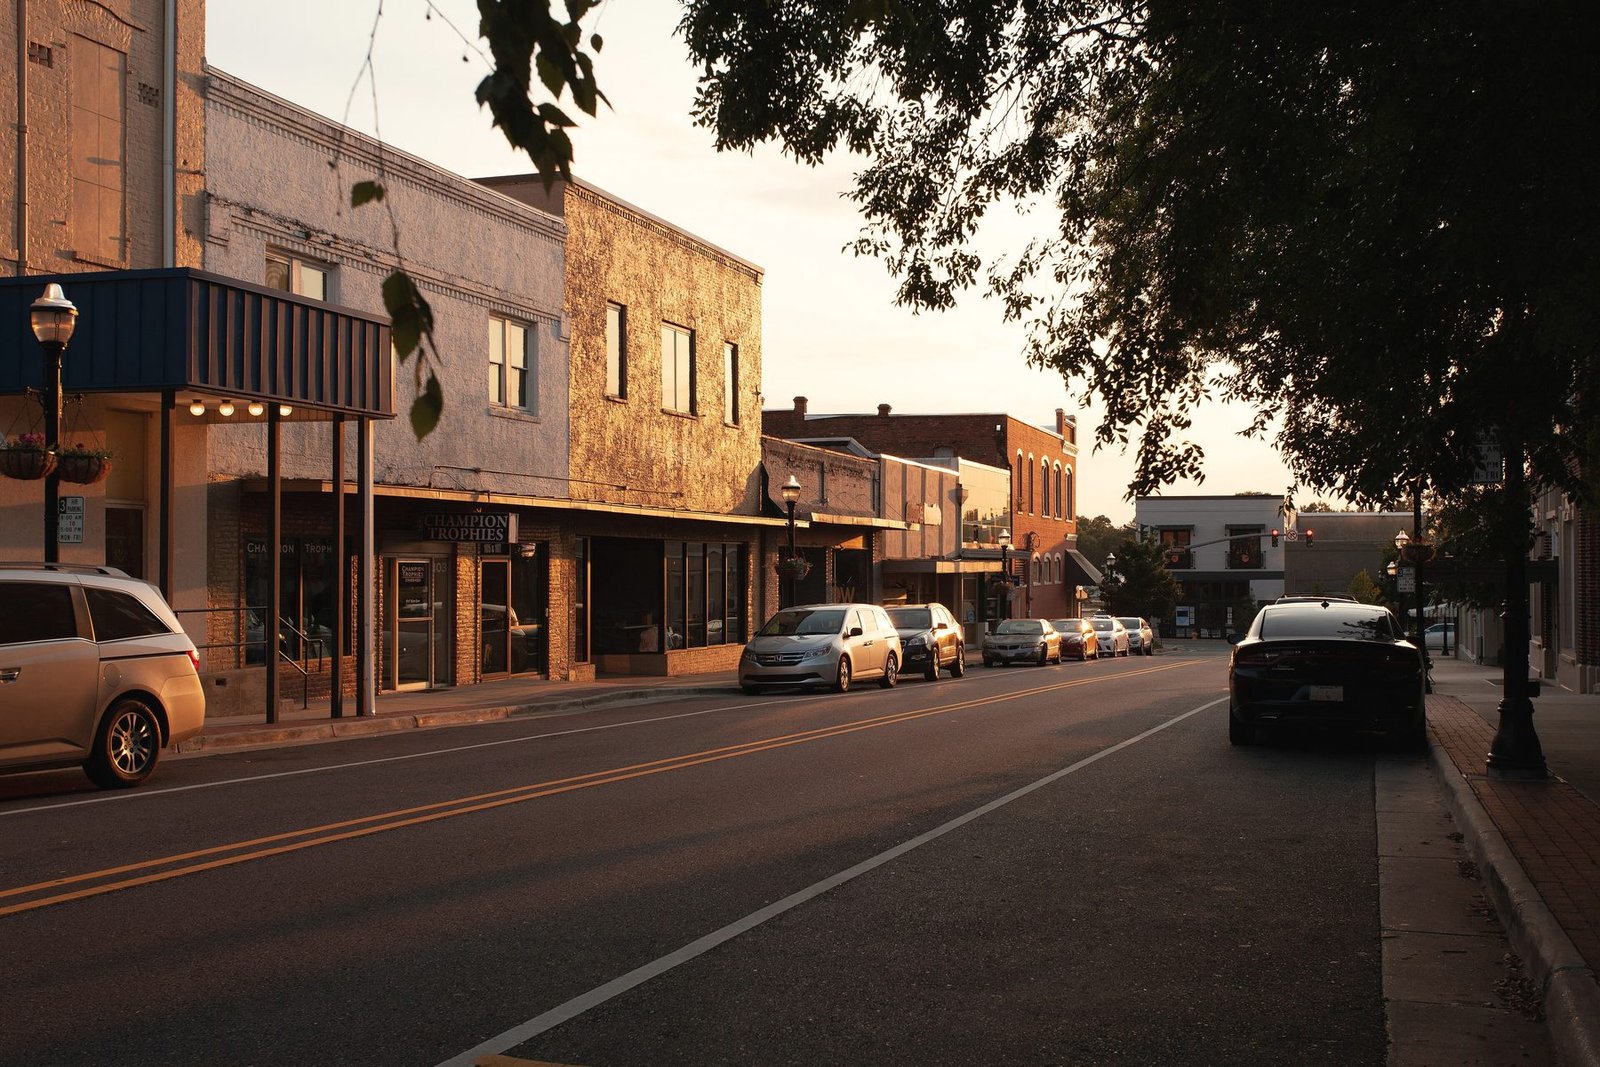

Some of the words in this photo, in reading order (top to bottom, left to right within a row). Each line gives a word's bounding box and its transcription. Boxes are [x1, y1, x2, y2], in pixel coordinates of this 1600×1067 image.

[1474, 471, 1499, 480] N-FRI
[60, 500, 65, 511] 3
[424, 514, 508, 528] CHAMPION
[428, 527, 504, 541] TROPHIES
[247, 542, 294, 553] CHAION
